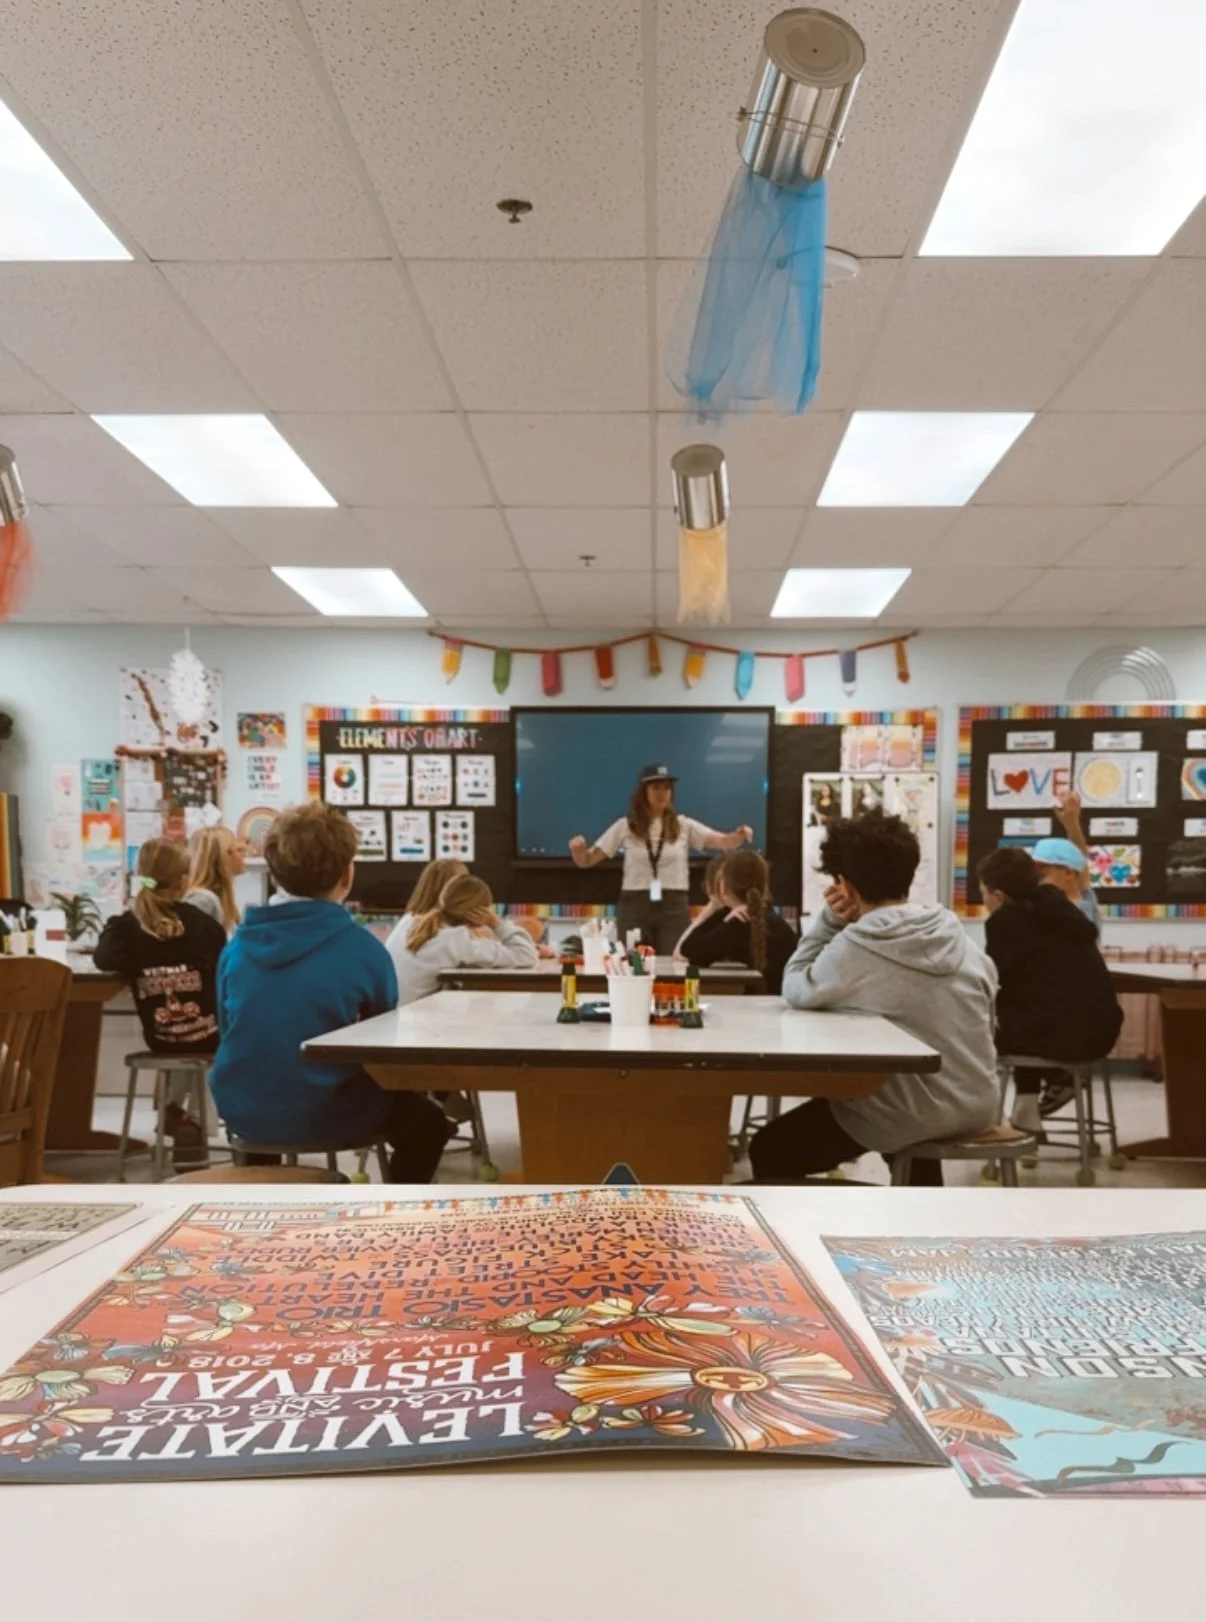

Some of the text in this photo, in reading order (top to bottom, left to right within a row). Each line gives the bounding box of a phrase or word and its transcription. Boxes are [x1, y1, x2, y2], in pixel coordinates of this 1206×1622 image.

[339, 726, 417, 749] ELEMENTS
[447, 727, 478, 749] ART
[317, 1251, 679, 1281] LAKE STREET DIVE
[369, 1243, 628, 1270] STICK FIGURE
[459, 1262, 610, 1283] STOOPID
[179, 1278, 431, 1296] REBELUTION
[254, 1271, 788, 1306] THE HEAD AND THE HEART
[277, 1283, 797, 1321] TREY ANASTASIO TRIO
[384, 1347, 404, 1361] 7
[413, 1340, 493, 1358] JULY
[939, 1338, 1203, 1356] FRIENDS
[187, 1354, 277, 1368] 2018
[139, 1352, 526, 1402] FESTIVAL
[352, 1385, 523, 1414] music
[120, 1400, 241, 1426] arts
[79, 1401, 525, 1462] LEVITATE
